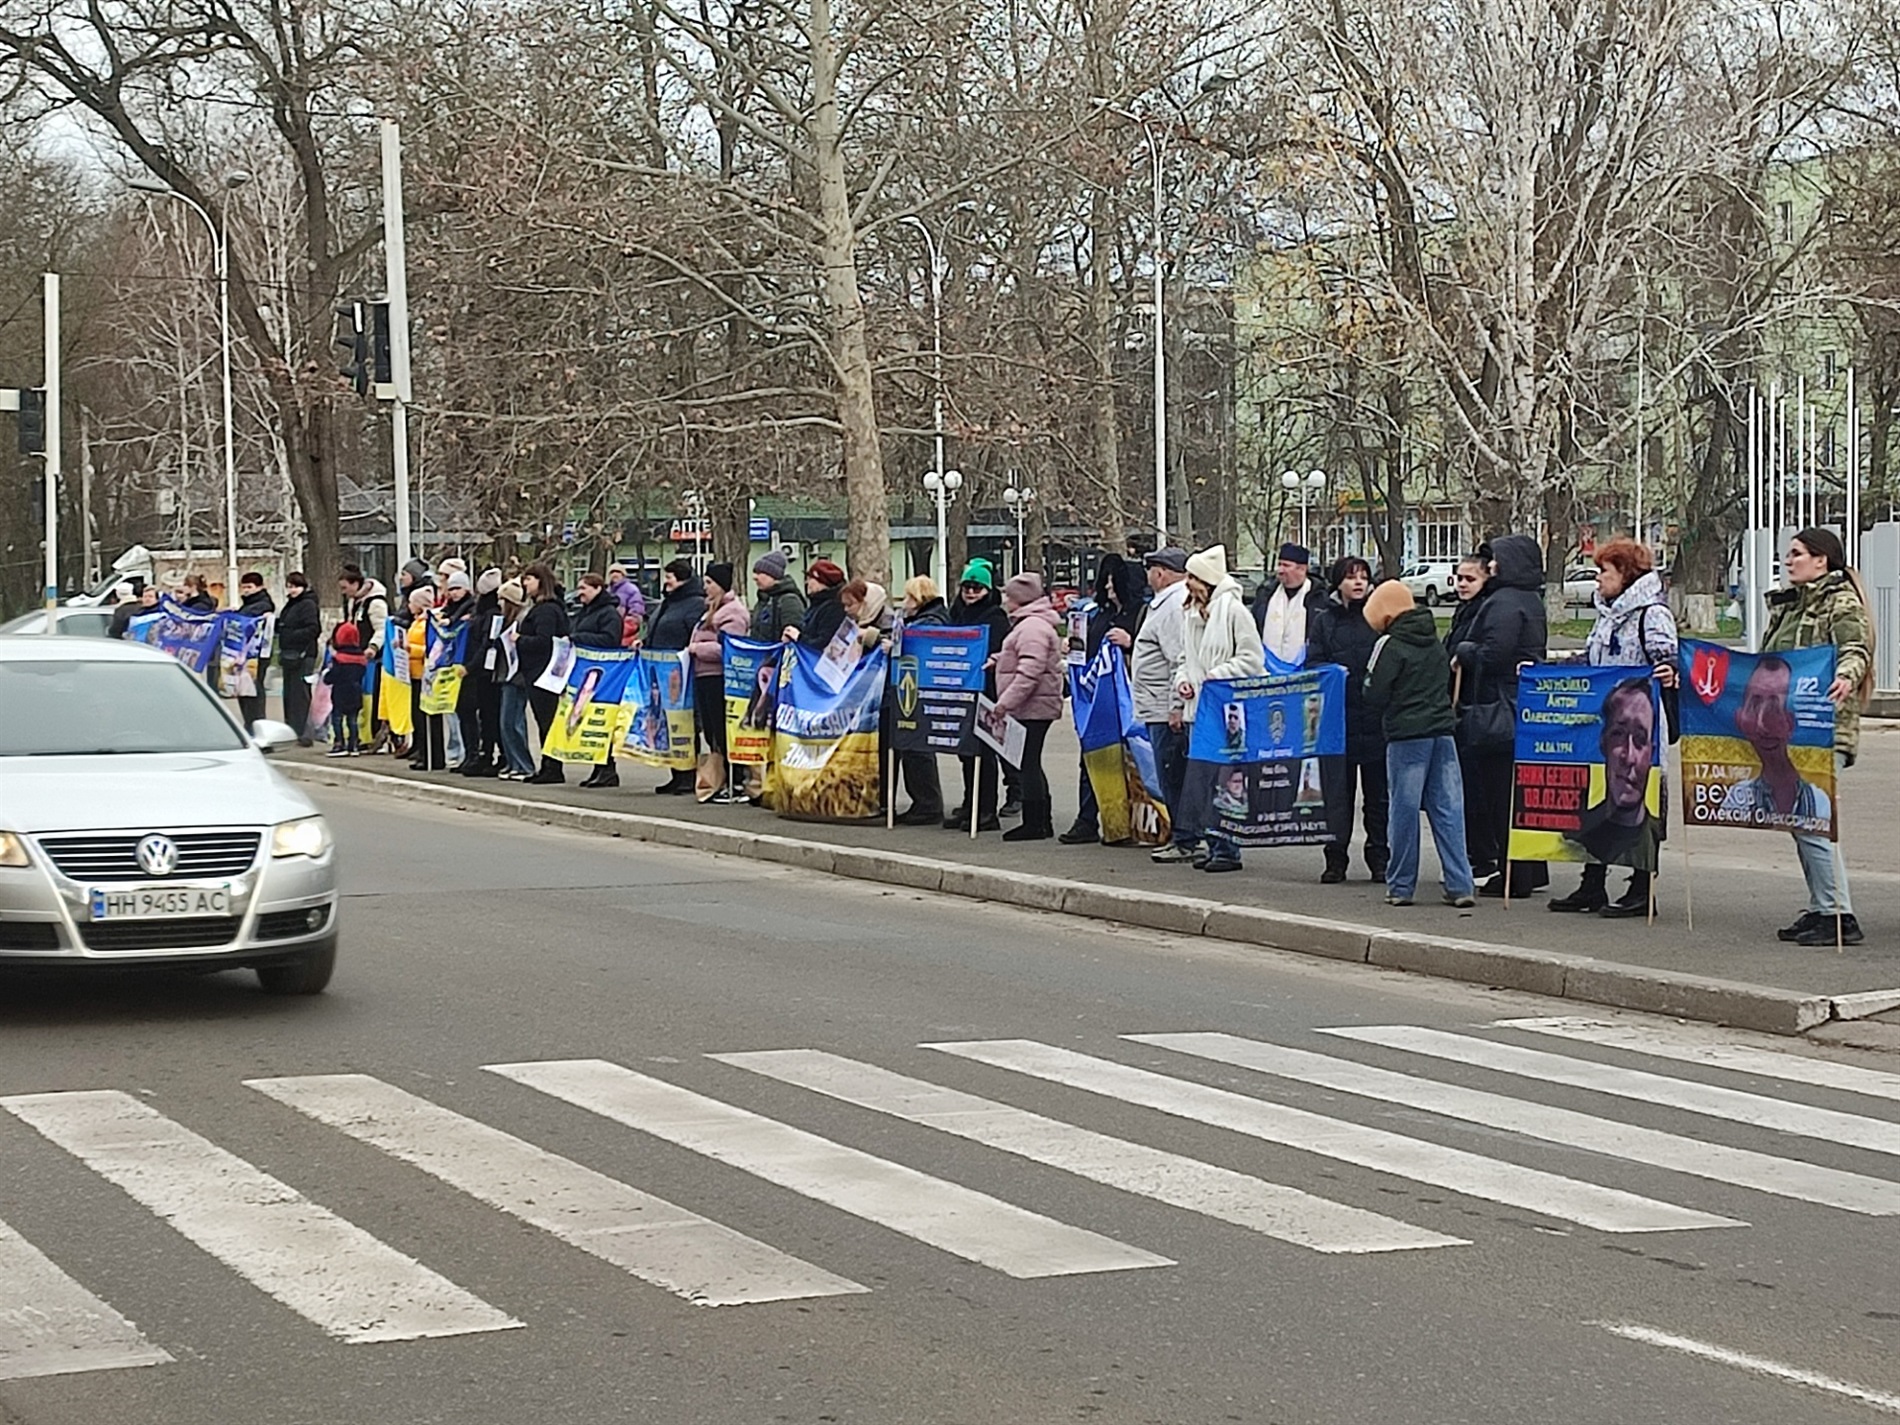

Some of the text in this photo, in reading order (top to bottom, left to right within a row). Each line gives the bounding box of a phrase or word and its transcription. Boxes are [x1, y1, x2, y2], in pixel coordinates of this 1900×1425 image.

[107, 892, 225, 915] HH 9455 AC
